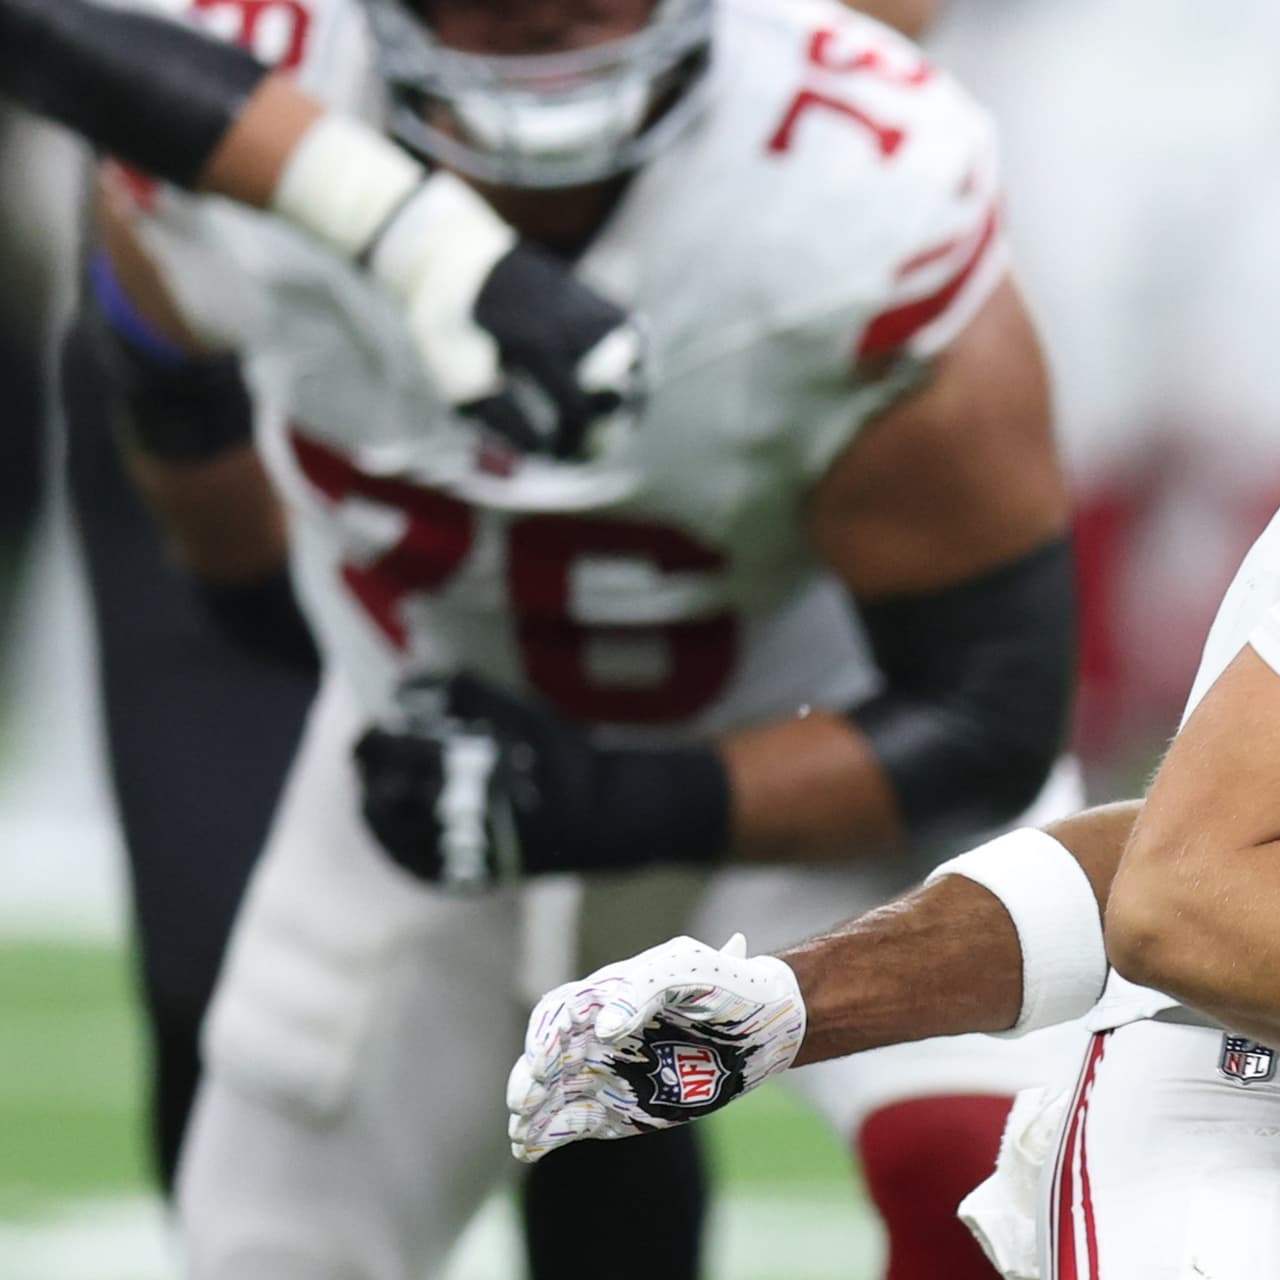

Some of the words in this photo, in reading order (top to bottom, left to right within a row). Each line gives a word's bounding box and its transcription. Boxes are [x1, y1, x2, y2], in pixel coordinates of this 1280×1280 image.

[766, 20, 940, 157] 76
[289, 425, 742, 725] 76
[677, 1048, 717, 1101] NFL
[1224, 1051, 1266, 1077] NFL
